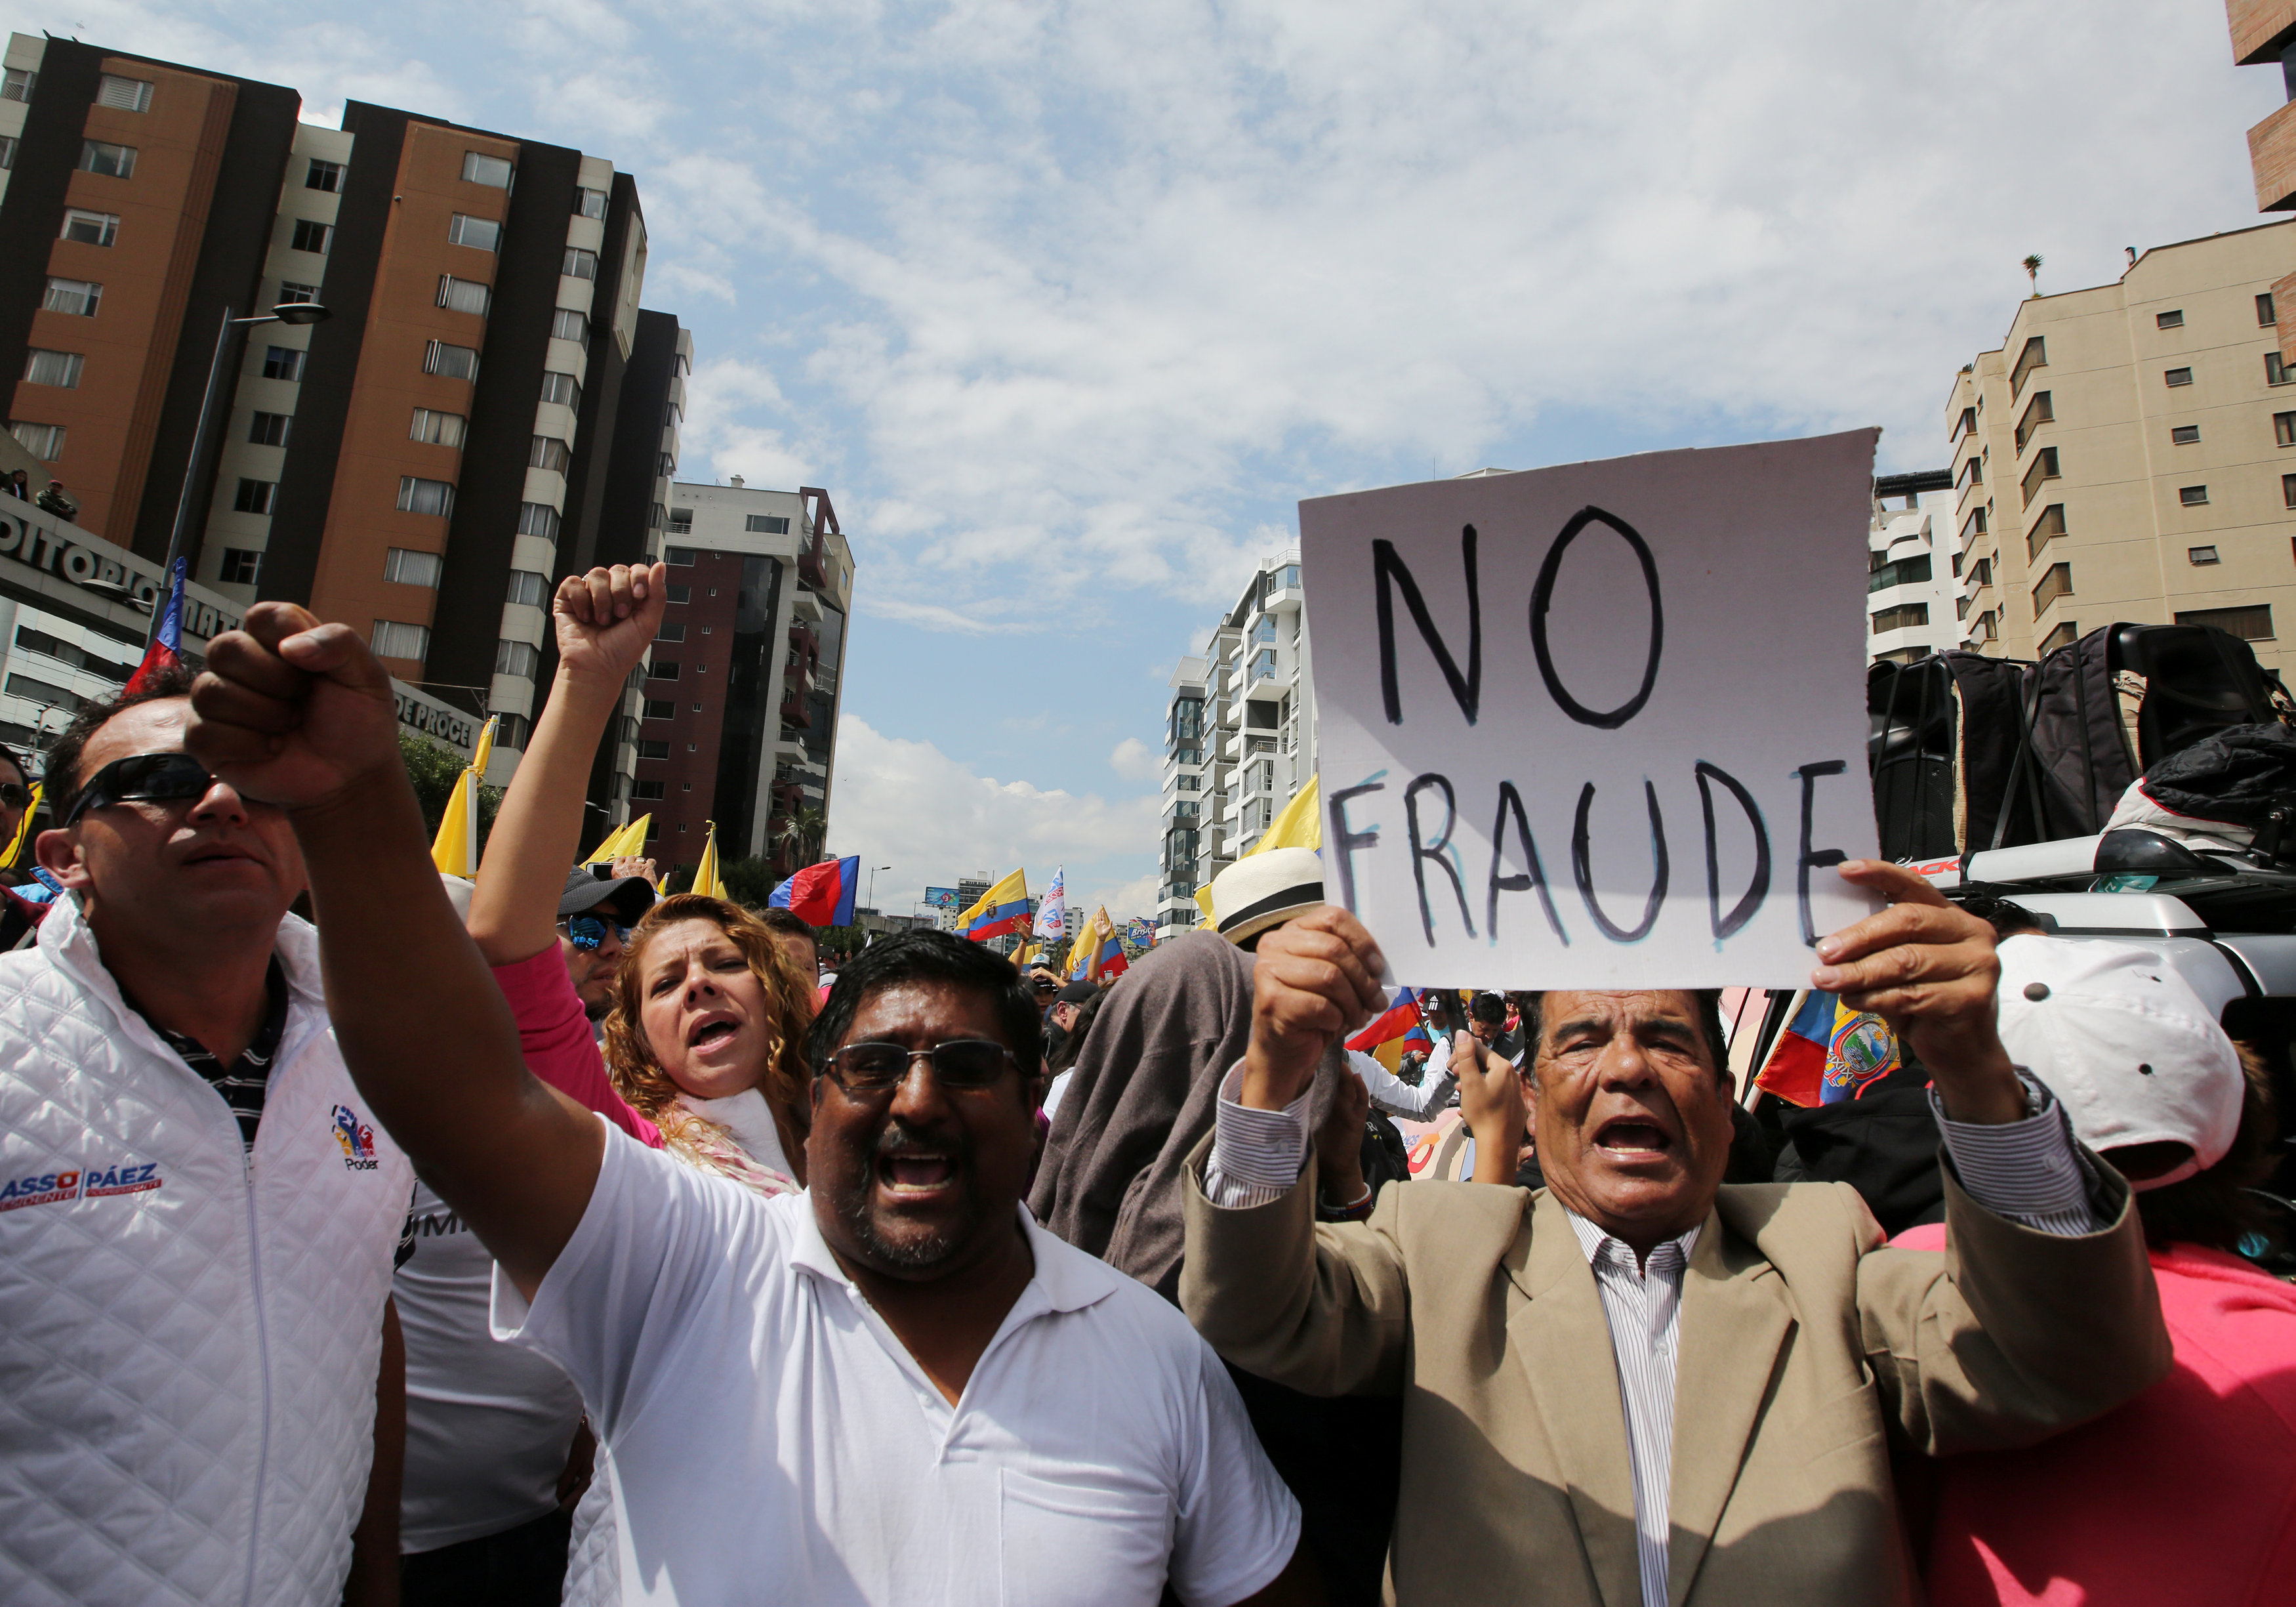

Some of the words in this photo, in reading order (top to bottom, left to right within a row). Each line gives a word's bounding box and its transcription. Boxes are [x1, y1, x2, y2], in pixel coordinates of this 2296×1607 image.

[1372, 505, 1664, 729] NO
[1328, 758, 1847, 950] FRAUDE
[85, 1162, 157, 1188] PÁEZ
[345, 1158, 379, 1171] Poder
